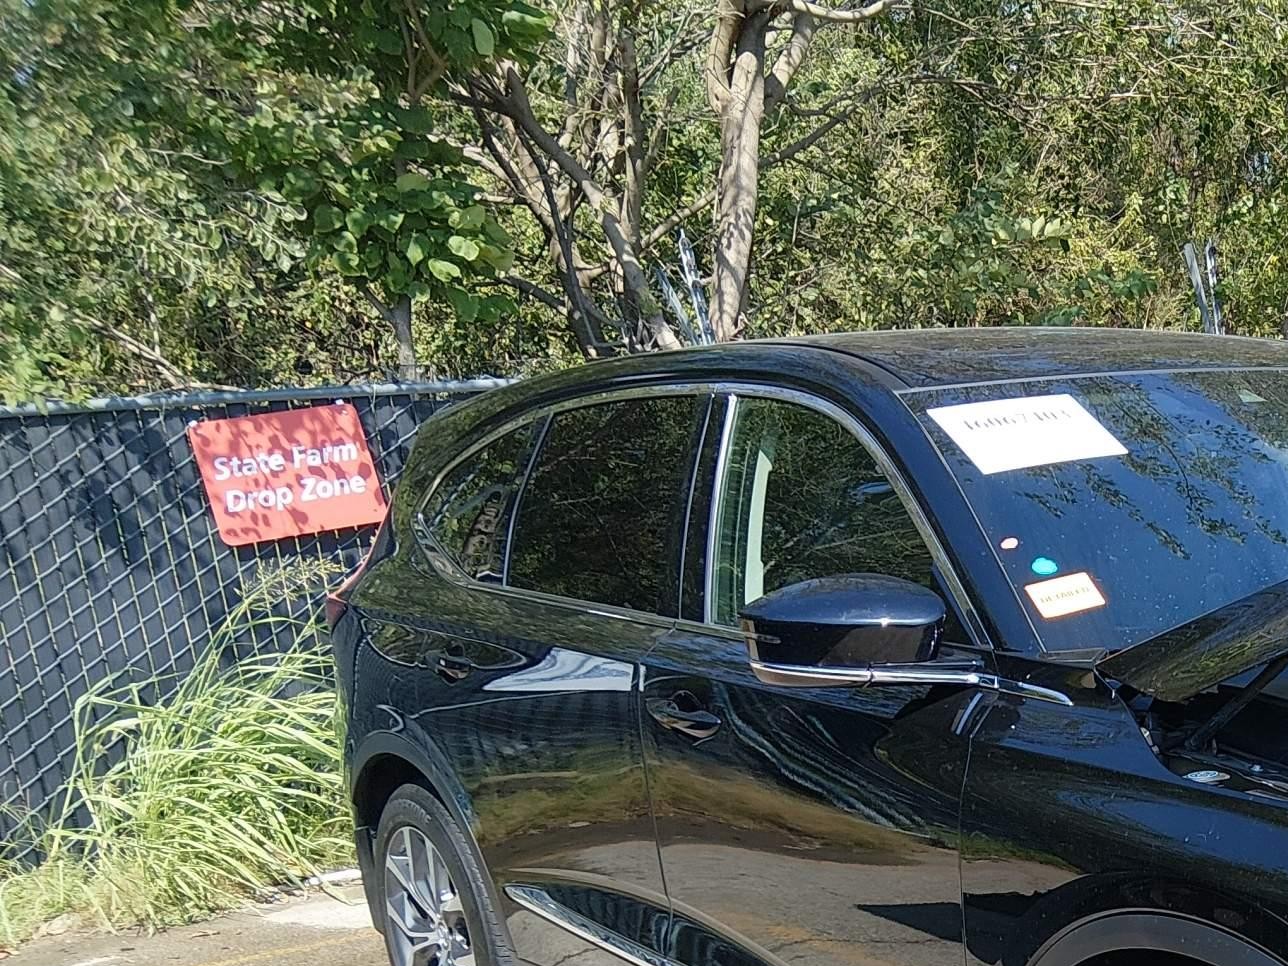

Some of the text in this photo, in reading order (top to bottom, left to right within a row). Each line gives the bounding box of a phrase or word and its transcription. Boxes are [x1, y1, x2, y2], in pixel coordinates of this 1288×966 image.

[213, 442, 358, 481] State Farm
[226, 475, 367, 513] Drop Zone
